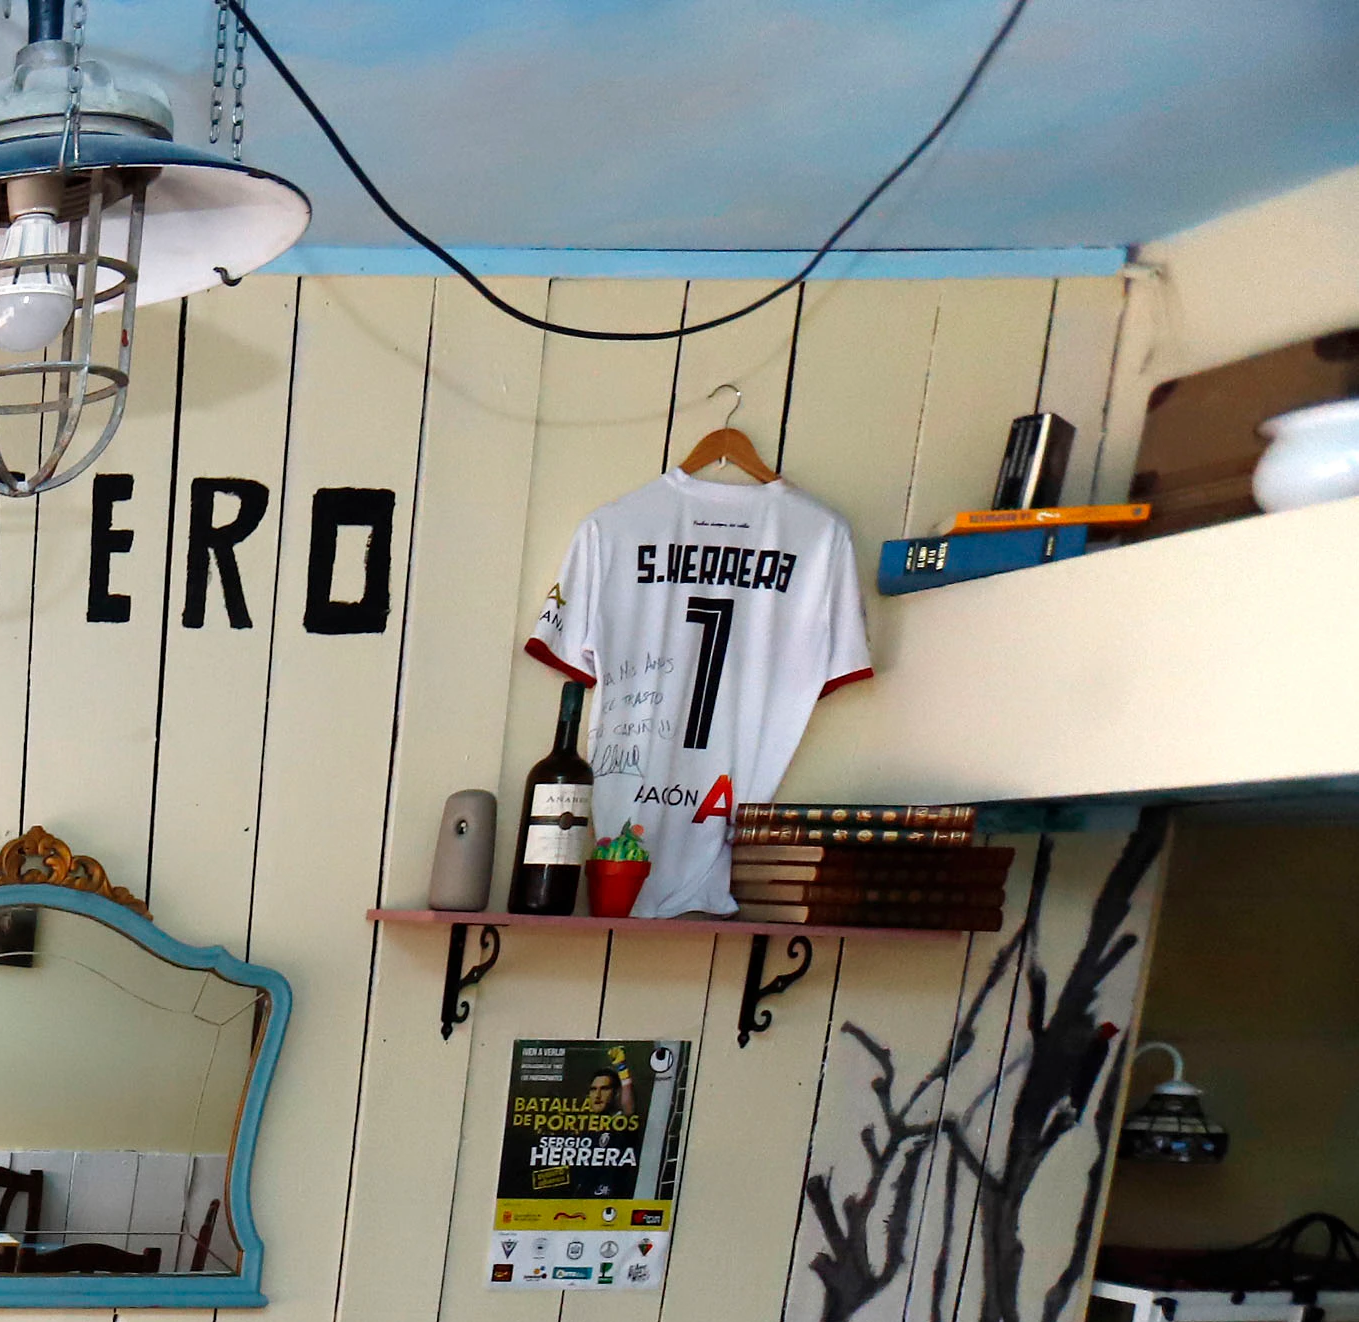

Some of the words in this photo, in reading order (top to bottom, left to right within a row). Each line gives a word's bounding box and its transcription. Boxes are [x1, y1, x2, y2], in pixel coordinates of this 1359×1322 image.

[514, 1097, 592, 1112] BATALLA
[513, 1114, 532, 1126] DE
[533, 1114, 639, 1131] PORTEROS
[539, 1136, 592, 1149] SERGIO
[529, 1146, 637, 1167] HERRERA
